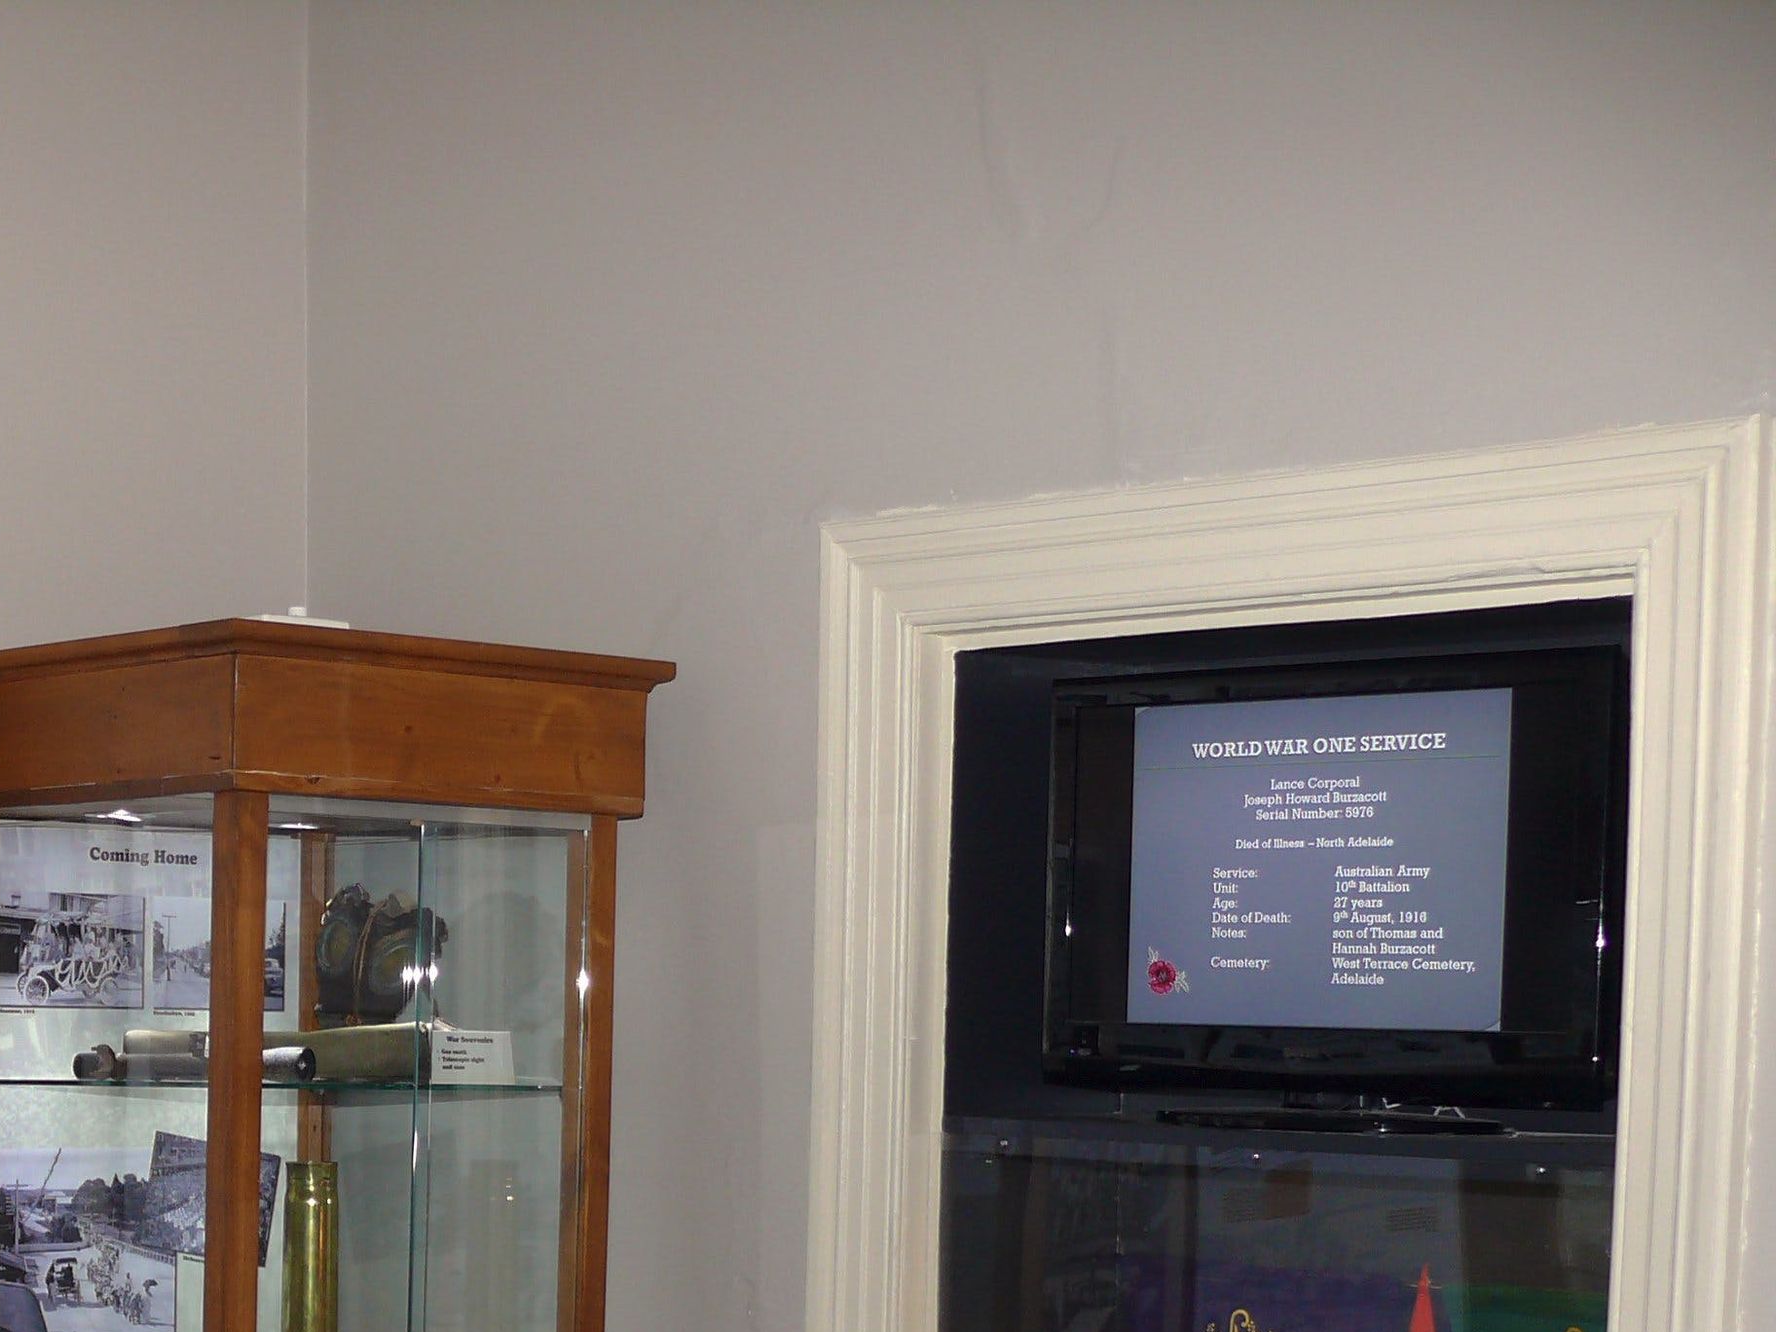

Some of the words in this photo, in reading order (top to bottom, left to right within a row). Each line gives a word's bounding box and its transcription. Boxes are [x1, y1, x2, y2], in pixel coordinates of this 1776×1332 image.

[1192, 741, 1262, 758] WORLD
[1265, 739, 1308, 755] WAR
[1313, 736, 1356, 754] ONE
[1359, 733, 1447, 751] SERVICE
[1271, 778, 1304, 790] Lance
[1308, 776, 1360, 792] Corporal
[1243, 794, 1282, 808] Joseph
[1285, 792, 1330, 804] Howard
[1332, 791, 1387, 803] Burzacott
[1256, 808, 1288, 820] Serial
[1292, 808, 1343, 819] Number:
[1345, 806, 1374, 818] 5976
[1235, 838, 1259, 849] Died
[1262, 838, 1271, 849] of
[1273, 838, 1304, 848] Illness
[1316, 837, 1345, 848] North
[1347, 837, 1394, 848] Adelaide
[90, 847, 150, 866] Coming
[154, 849, 198, 865] Home
[1213, 867, 1258, 879] Service:
[1335, 865, 1393, 877] Australian
[1397, 865, 1430, 879] Army
[1213, 882, 1239, 894] Unit:
[1335, 880, 1357, 892] 10th
[1359, 881, 1410, 892] Battalion
[1212, 898, 1238, 910] Age:
[1334, 898, 1347, 908] 27
[1351, 898, 1383, 911] years
[1212, 912, 1238, 923] Date
[1241, 912, 1252, 923] of
[1254, 912, 1291, 924] Death:
[1333, 911, 1348, 923] 9th
[1350, 912, 1395, 924] August,
[1212, 927, 1246, 939] Notes:
[1332, 928, 1353, 939] son
[1355, 928, 1367, 939] of
[1370, 928, 1416, 939] Thomas
[1420, 927, 1443, 939] and
[1332, 943, 1376, 955] Hannah
[1380, 943, 1435, 955] Burzacott
[1211, 956, 1270, 970] Cemetery:
[1332, 958, 1360, 970] West
[1362, 958, 1408, 970] Terrace
[1412, 958, 1476, 972] Cemetery,
[1331, 973, 1384, 985] Adelaide
